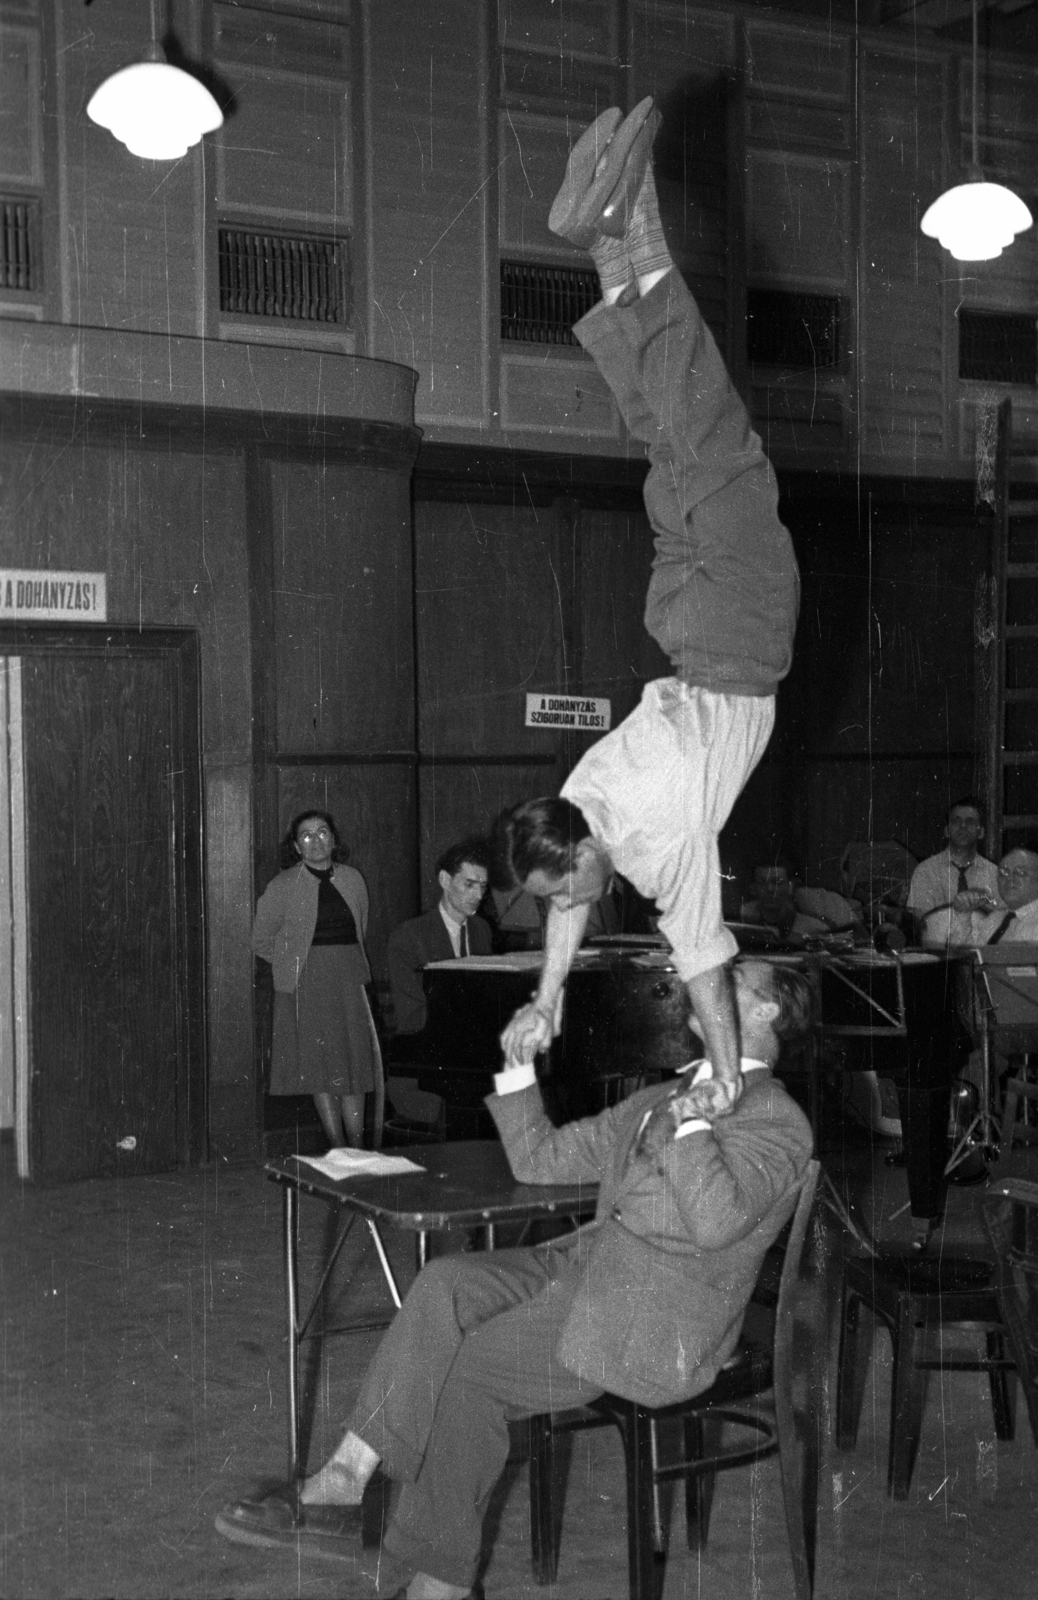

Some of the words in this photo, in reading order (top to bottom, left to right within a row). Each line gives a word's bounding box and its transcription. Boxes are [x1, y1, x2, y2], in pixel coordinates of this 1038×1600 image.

[5, 580, 13, 609] A
[541, 699, 546, 710] A
[578, 714, 605, 727] TILOS!
